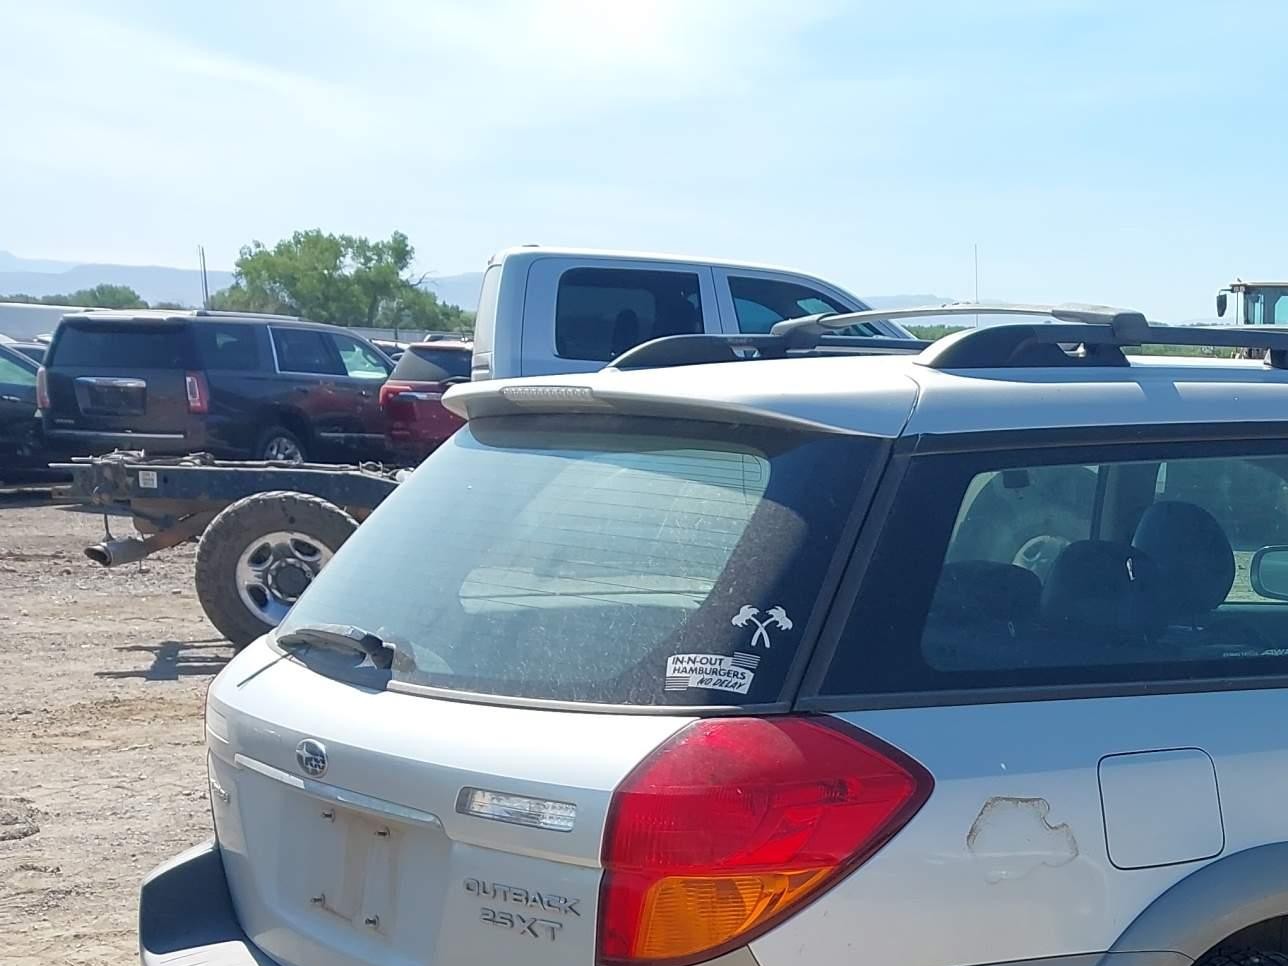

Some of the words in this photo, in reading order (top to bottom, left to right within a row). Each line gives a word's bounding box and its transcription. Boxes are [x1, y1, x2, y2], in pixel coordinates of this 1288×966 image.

[672, 657, 725, 667] IN-N-OUT
[673, 667, 746, 680] HAMBURGERS
[713, 680, 745, 690] DELAY
[464, 878, 582, 917] OUTBACK
